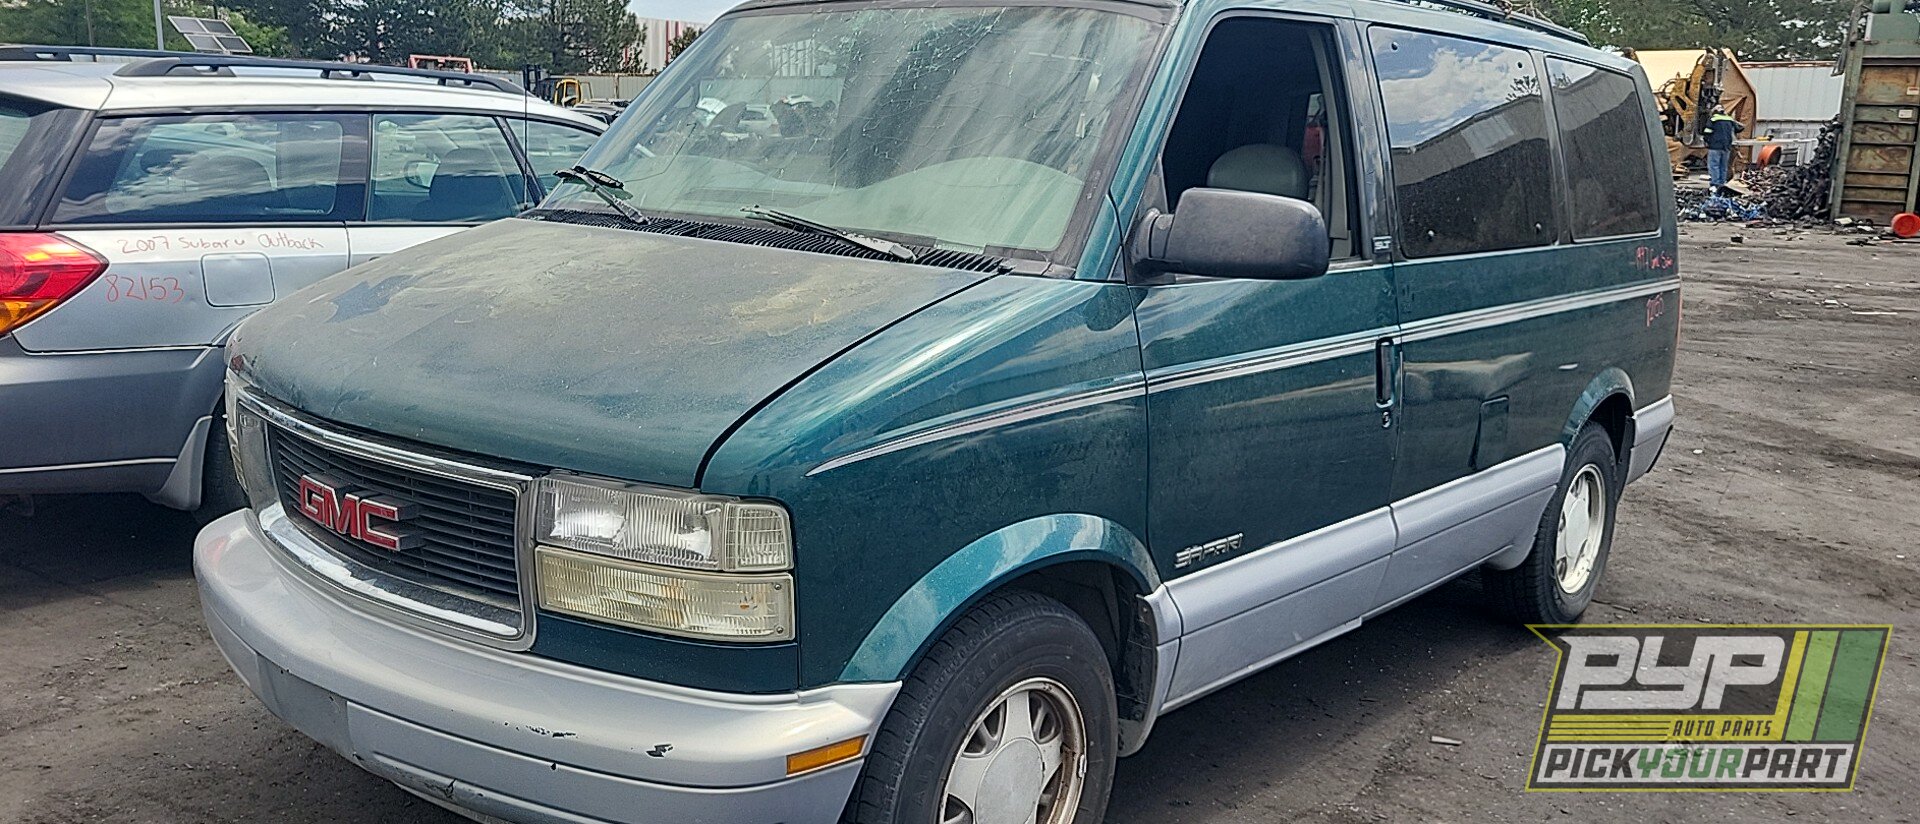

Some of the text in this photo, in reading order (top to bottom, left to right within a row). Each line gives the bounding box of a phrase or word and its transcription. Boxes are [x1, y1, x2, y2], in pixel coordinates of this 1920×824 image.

[117, 232, 325, 255] 2007 Subaru Outback
[105, 274, 184, 304] 82153
[300, 475, 401, 551] GMC
[1174, 532, 1243, 568] SAFARI
